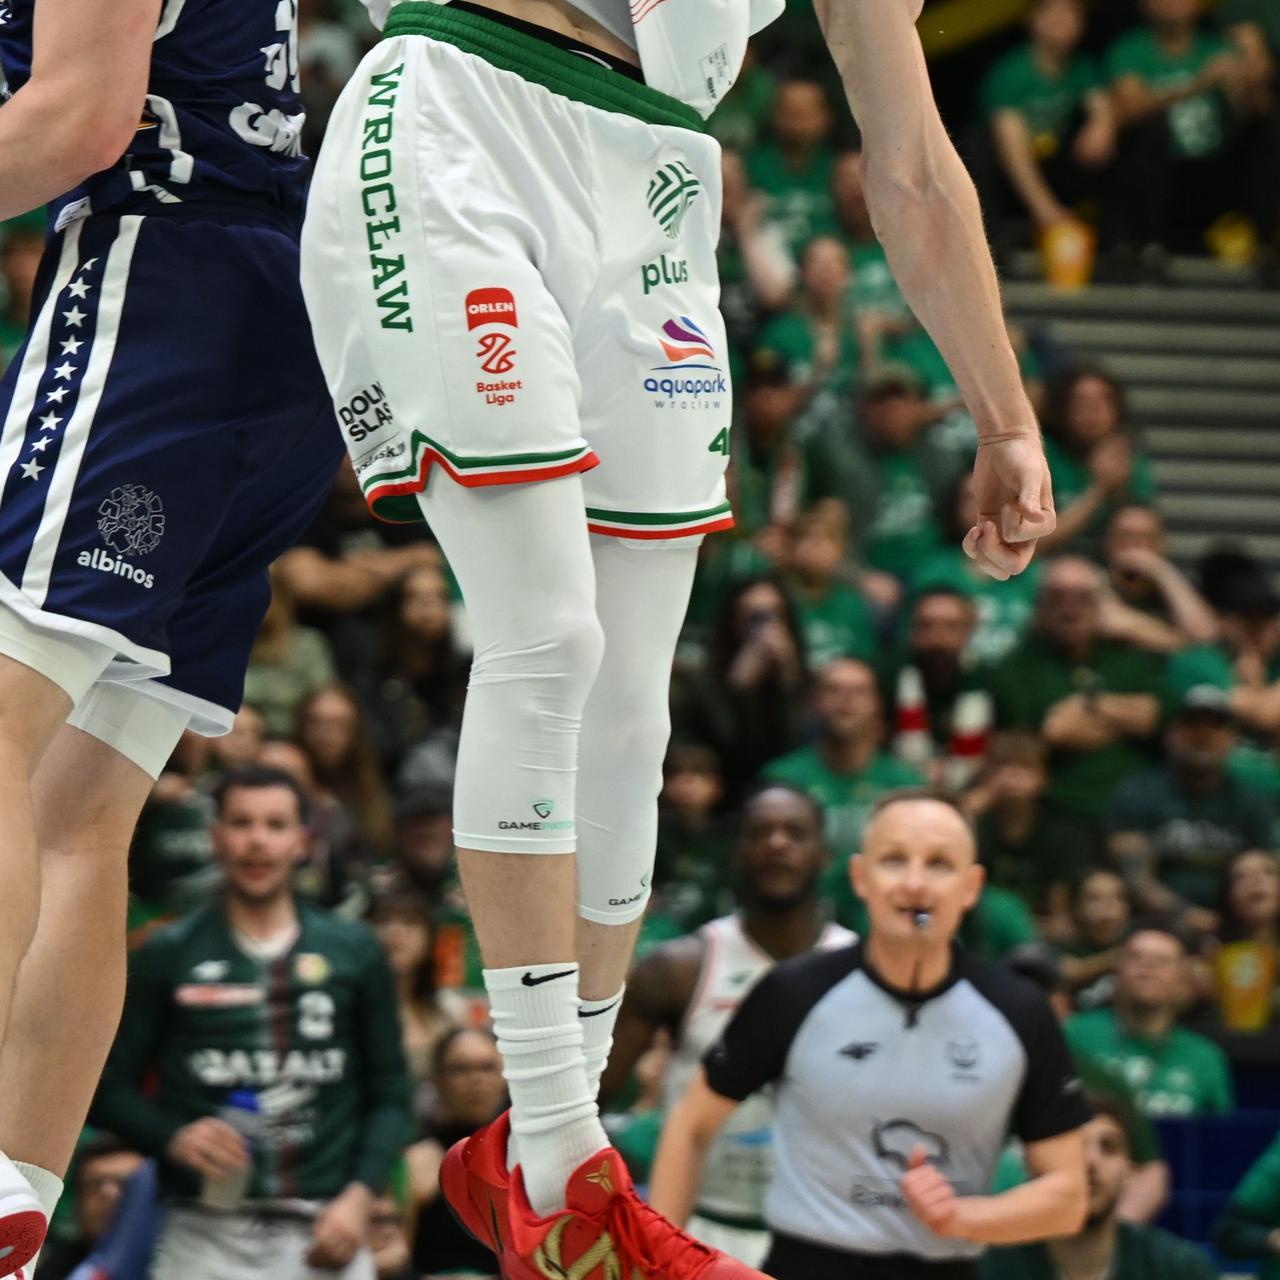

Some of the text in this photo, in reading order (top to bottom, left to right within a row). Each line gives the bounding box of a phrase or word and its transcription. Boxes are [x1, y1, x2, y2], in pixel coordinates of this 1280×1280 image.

[360, 63, 413, 333] WROCŁAW
[641, 255, 688, 294] plus
[468, 303, 514, 314] ORLEN
[477, 381, 522, 392] Basket
[644, 373, 726, 399] aquapark
[486, 394, 514, 405] Liga
[77, 548, 155, 589] albinos
